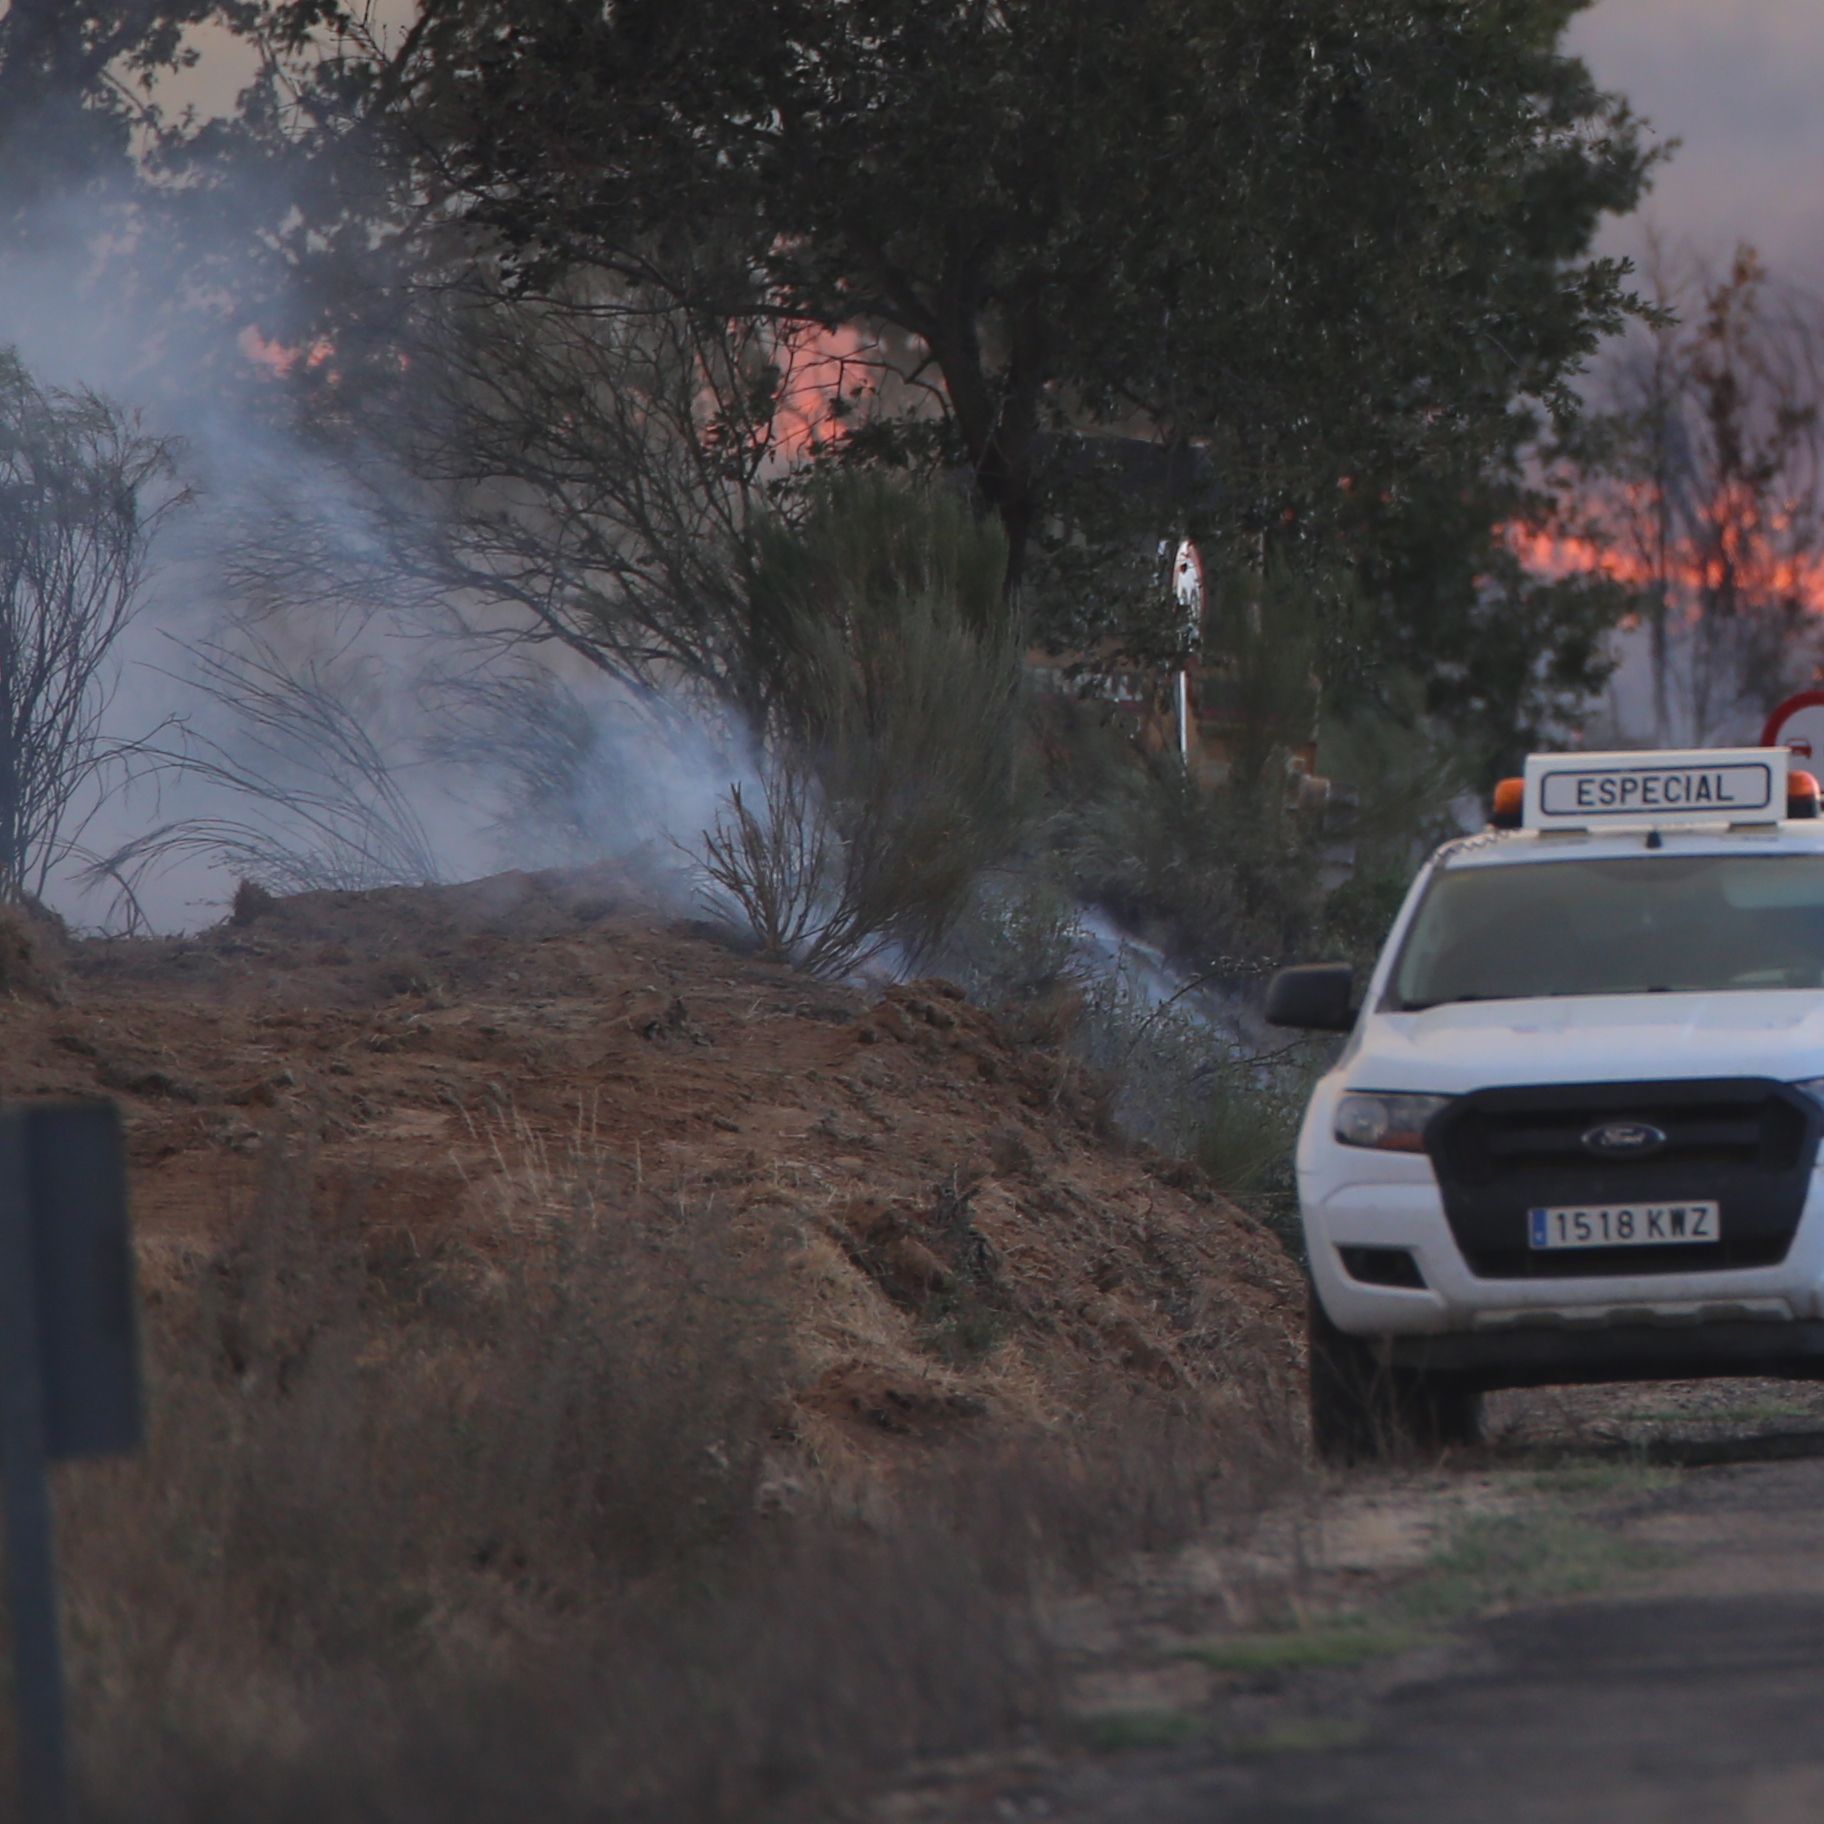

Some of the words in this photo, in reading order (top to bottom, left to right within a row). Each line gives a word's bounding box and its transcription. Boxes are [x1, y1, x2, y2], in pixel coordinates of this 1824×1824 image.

[1576, 774, 1735, 807] ESPECIAL
[1556, 1211, 1635, 1241] 1518
[1647, 1207, 1709, 1239] KWZ
